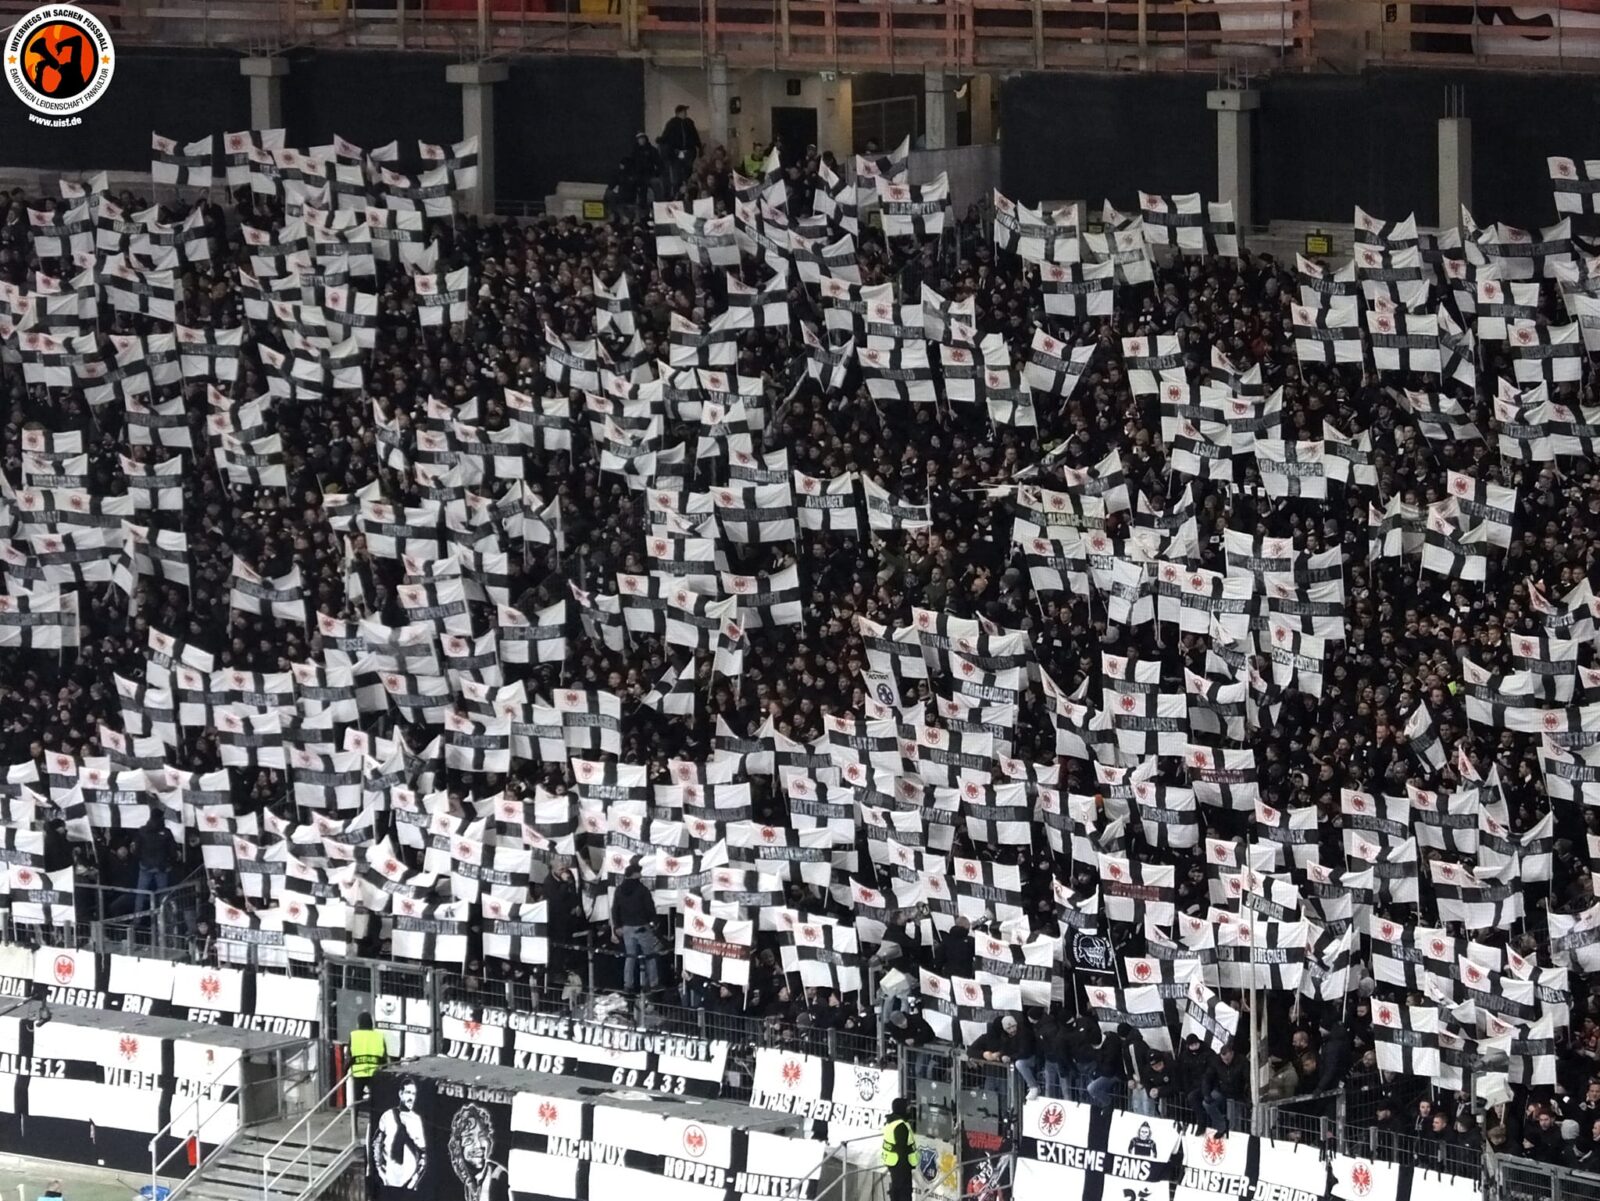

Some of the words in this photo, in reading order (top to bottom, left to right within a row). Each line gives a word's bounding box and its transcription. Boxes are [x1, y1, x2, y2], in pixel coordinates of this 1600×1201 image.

[233, 1013, 312, 1039] VICTORIA
[449, 1040, 500, 1065] ULTRA
[1036, 1140, 1106, 1172] EXTREME
[1112, 1154, 1151, 1181] FANS
